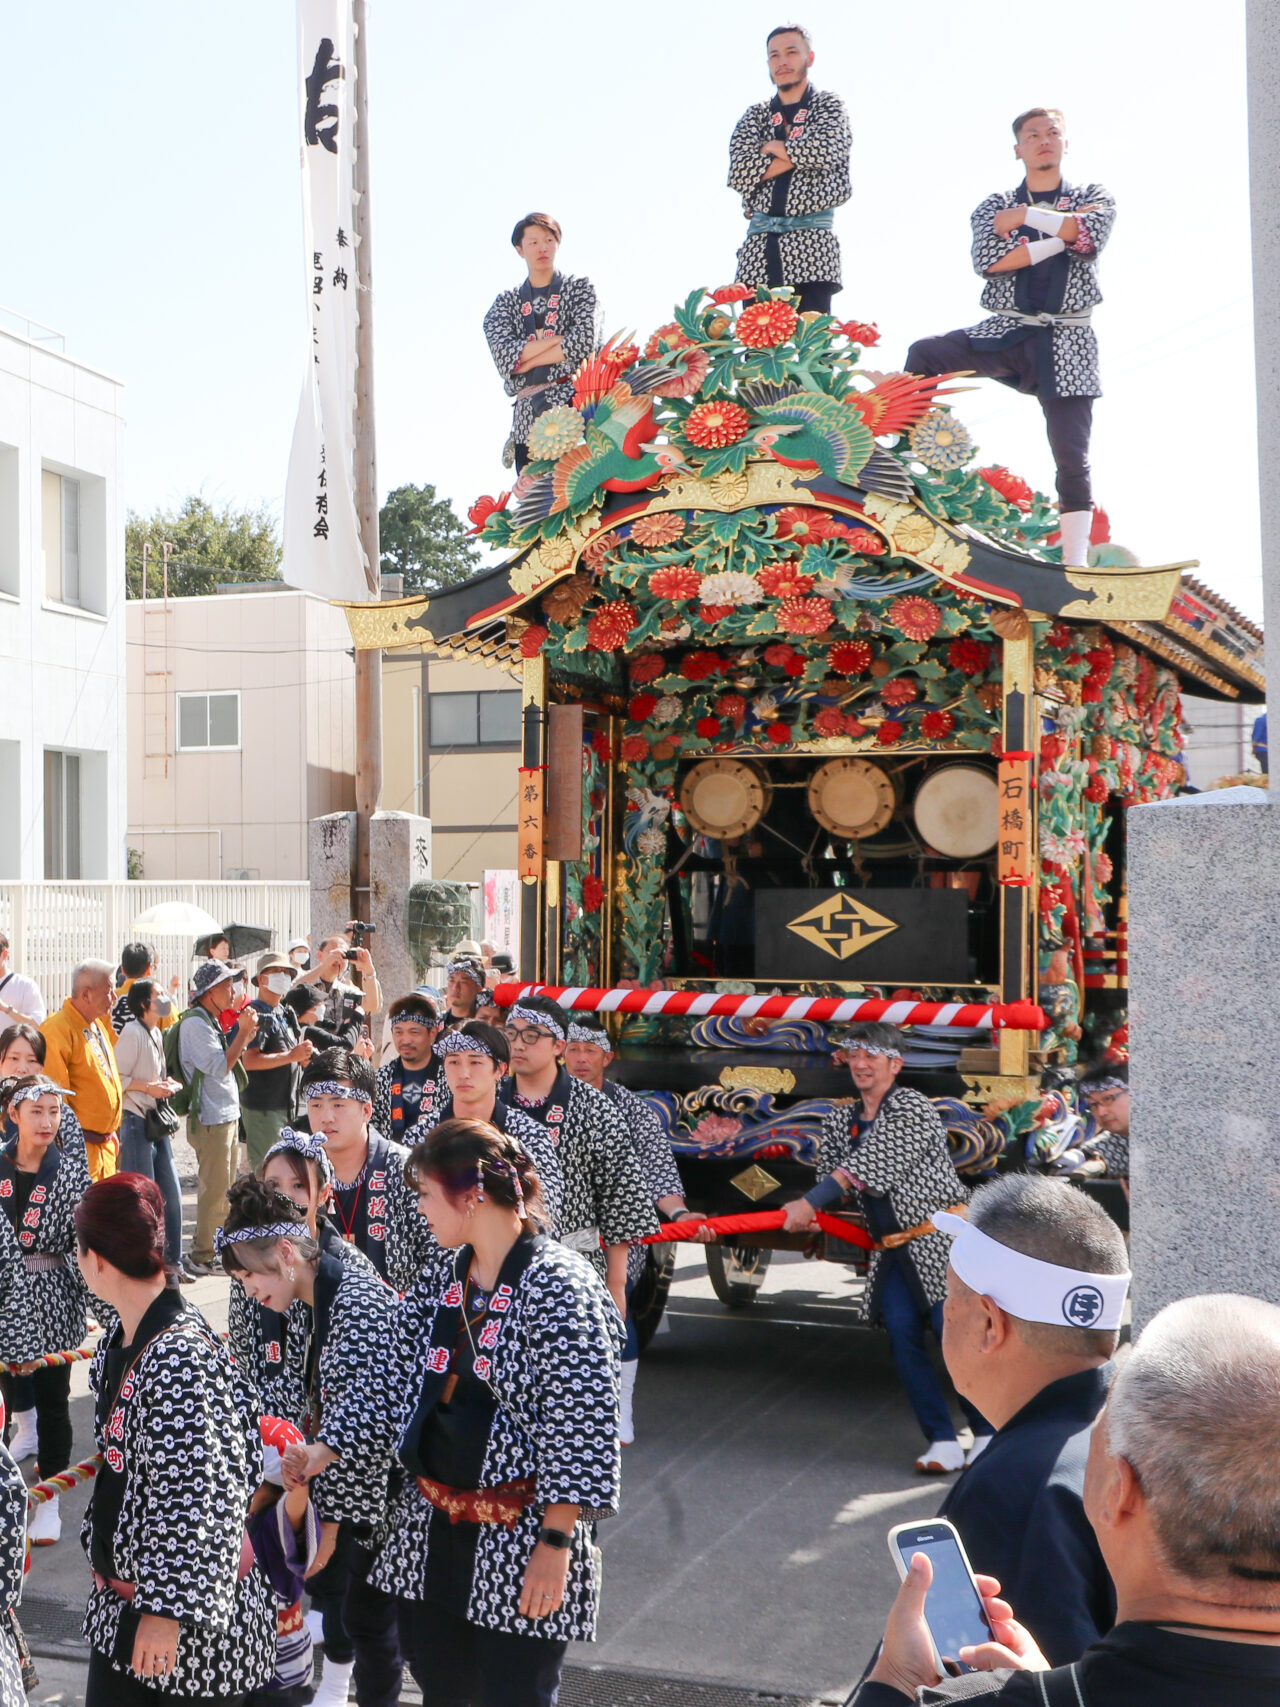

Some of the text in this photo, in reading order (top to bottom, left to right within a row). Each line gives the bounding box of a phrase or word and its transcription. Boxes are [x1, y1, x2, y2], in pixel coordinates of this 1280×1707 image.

[523, 785, 538, 859] 第六番
[1001, 776, 1024, 861] 石橋町
[20, 1185, 46, 1247] 石橋町
[368, 1171, 387, 1240] 石橋町
[266, 1342, 281, 1363] 連
[473, 1284, 512, 1380] 石橋町
